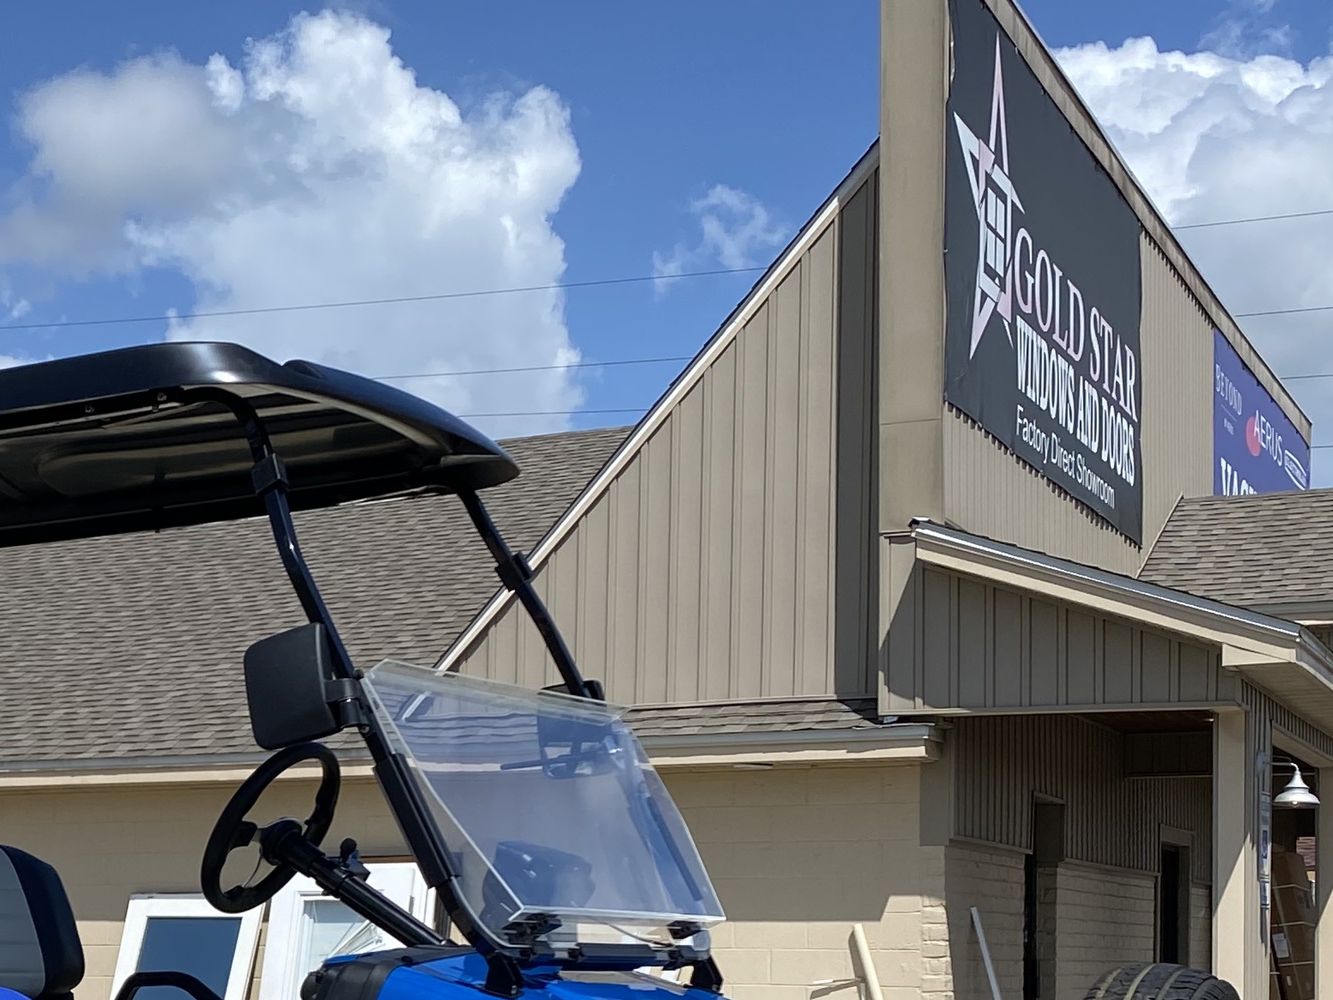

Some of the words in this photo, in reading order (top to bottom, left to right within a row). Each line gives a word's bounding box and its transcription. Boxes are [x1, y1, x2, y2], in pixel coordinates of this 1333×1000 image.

[1014, 227, 1085, 362] GOLD
[1089, 306, 1138, 423] STAR
[1016, 315, 1075, 434] WINDOWS
[1076, 376, 1100, 454] AND
[1101, 397, 1135, 487] DOORS
[1215, 363, 1243, 416] BEYOND
[1016, 404, 1050, 464] Factory
[1051, 432, 1075, 479] Direct
[1076, 453, 1115, 509] Showroom
[1220, 456, 1258, 497] VA
[1253, 409, 1284, 467] AERUS
